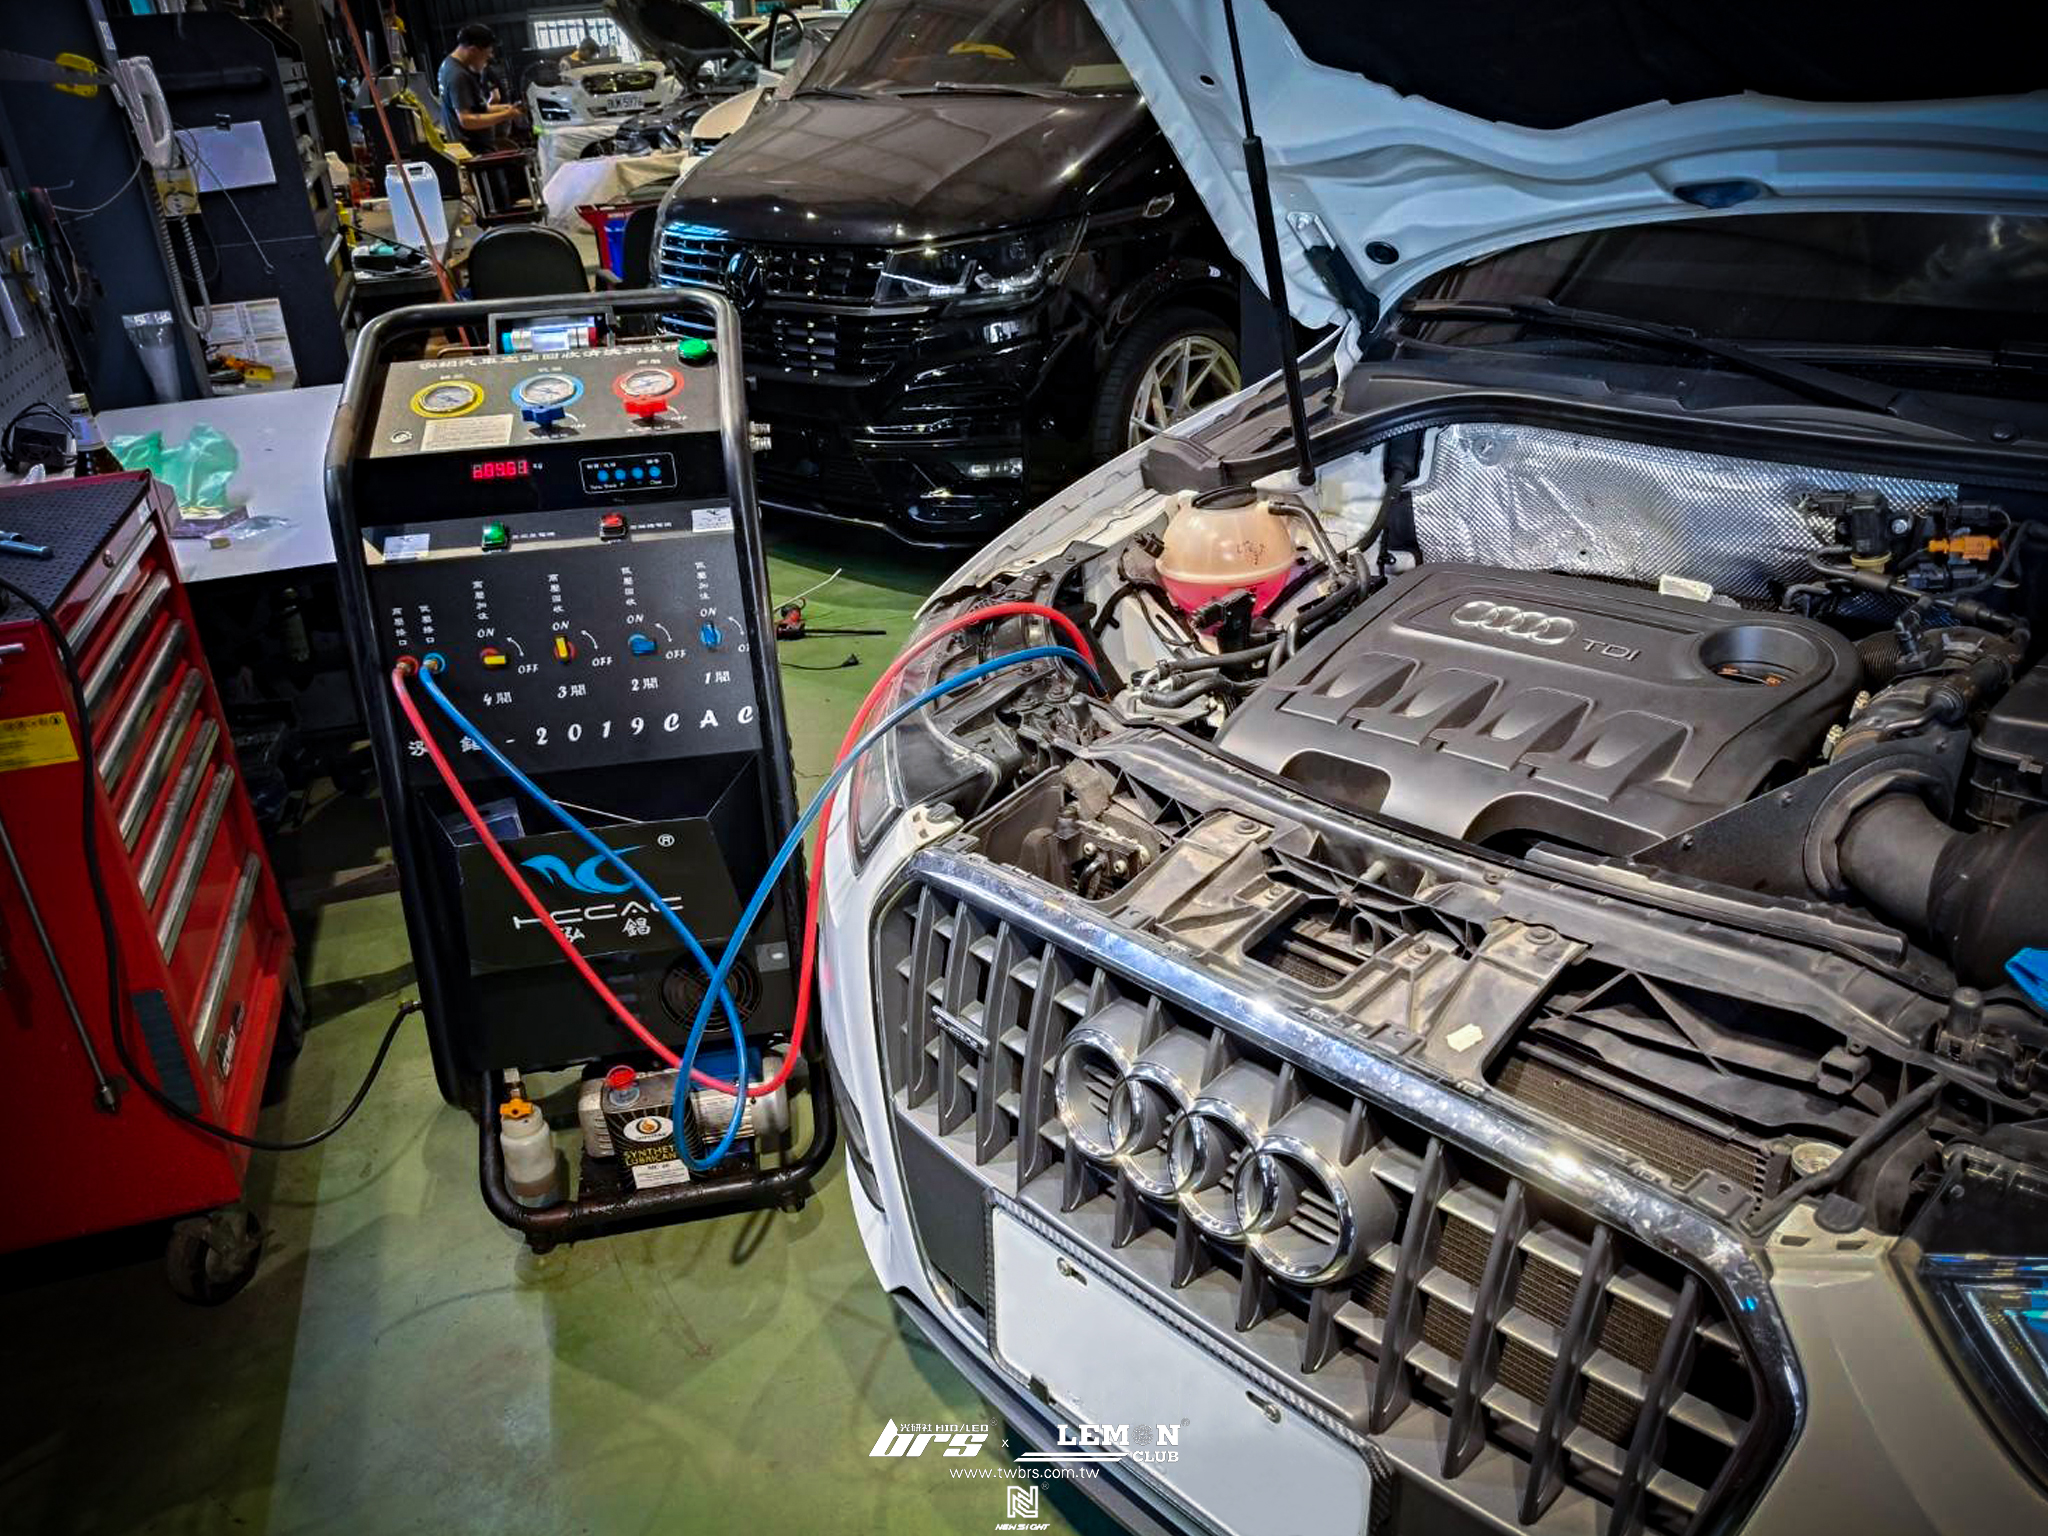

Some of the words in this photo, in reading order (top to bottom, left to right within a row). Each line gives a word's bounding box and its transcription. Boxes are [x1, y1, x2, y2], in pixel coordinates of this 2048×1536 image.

[701, 607, 717, 617] ON
[627, 614, 644, 624] ON
[552, 621, 570, 631] ON
[477, 628, 495, 638] ON
[1583, 638, 1641, 661] TDI
[665, 650, 686, 660] OFF
[592, 656, 613, 667] OFF
[517, 664, 539, 675] OFF
